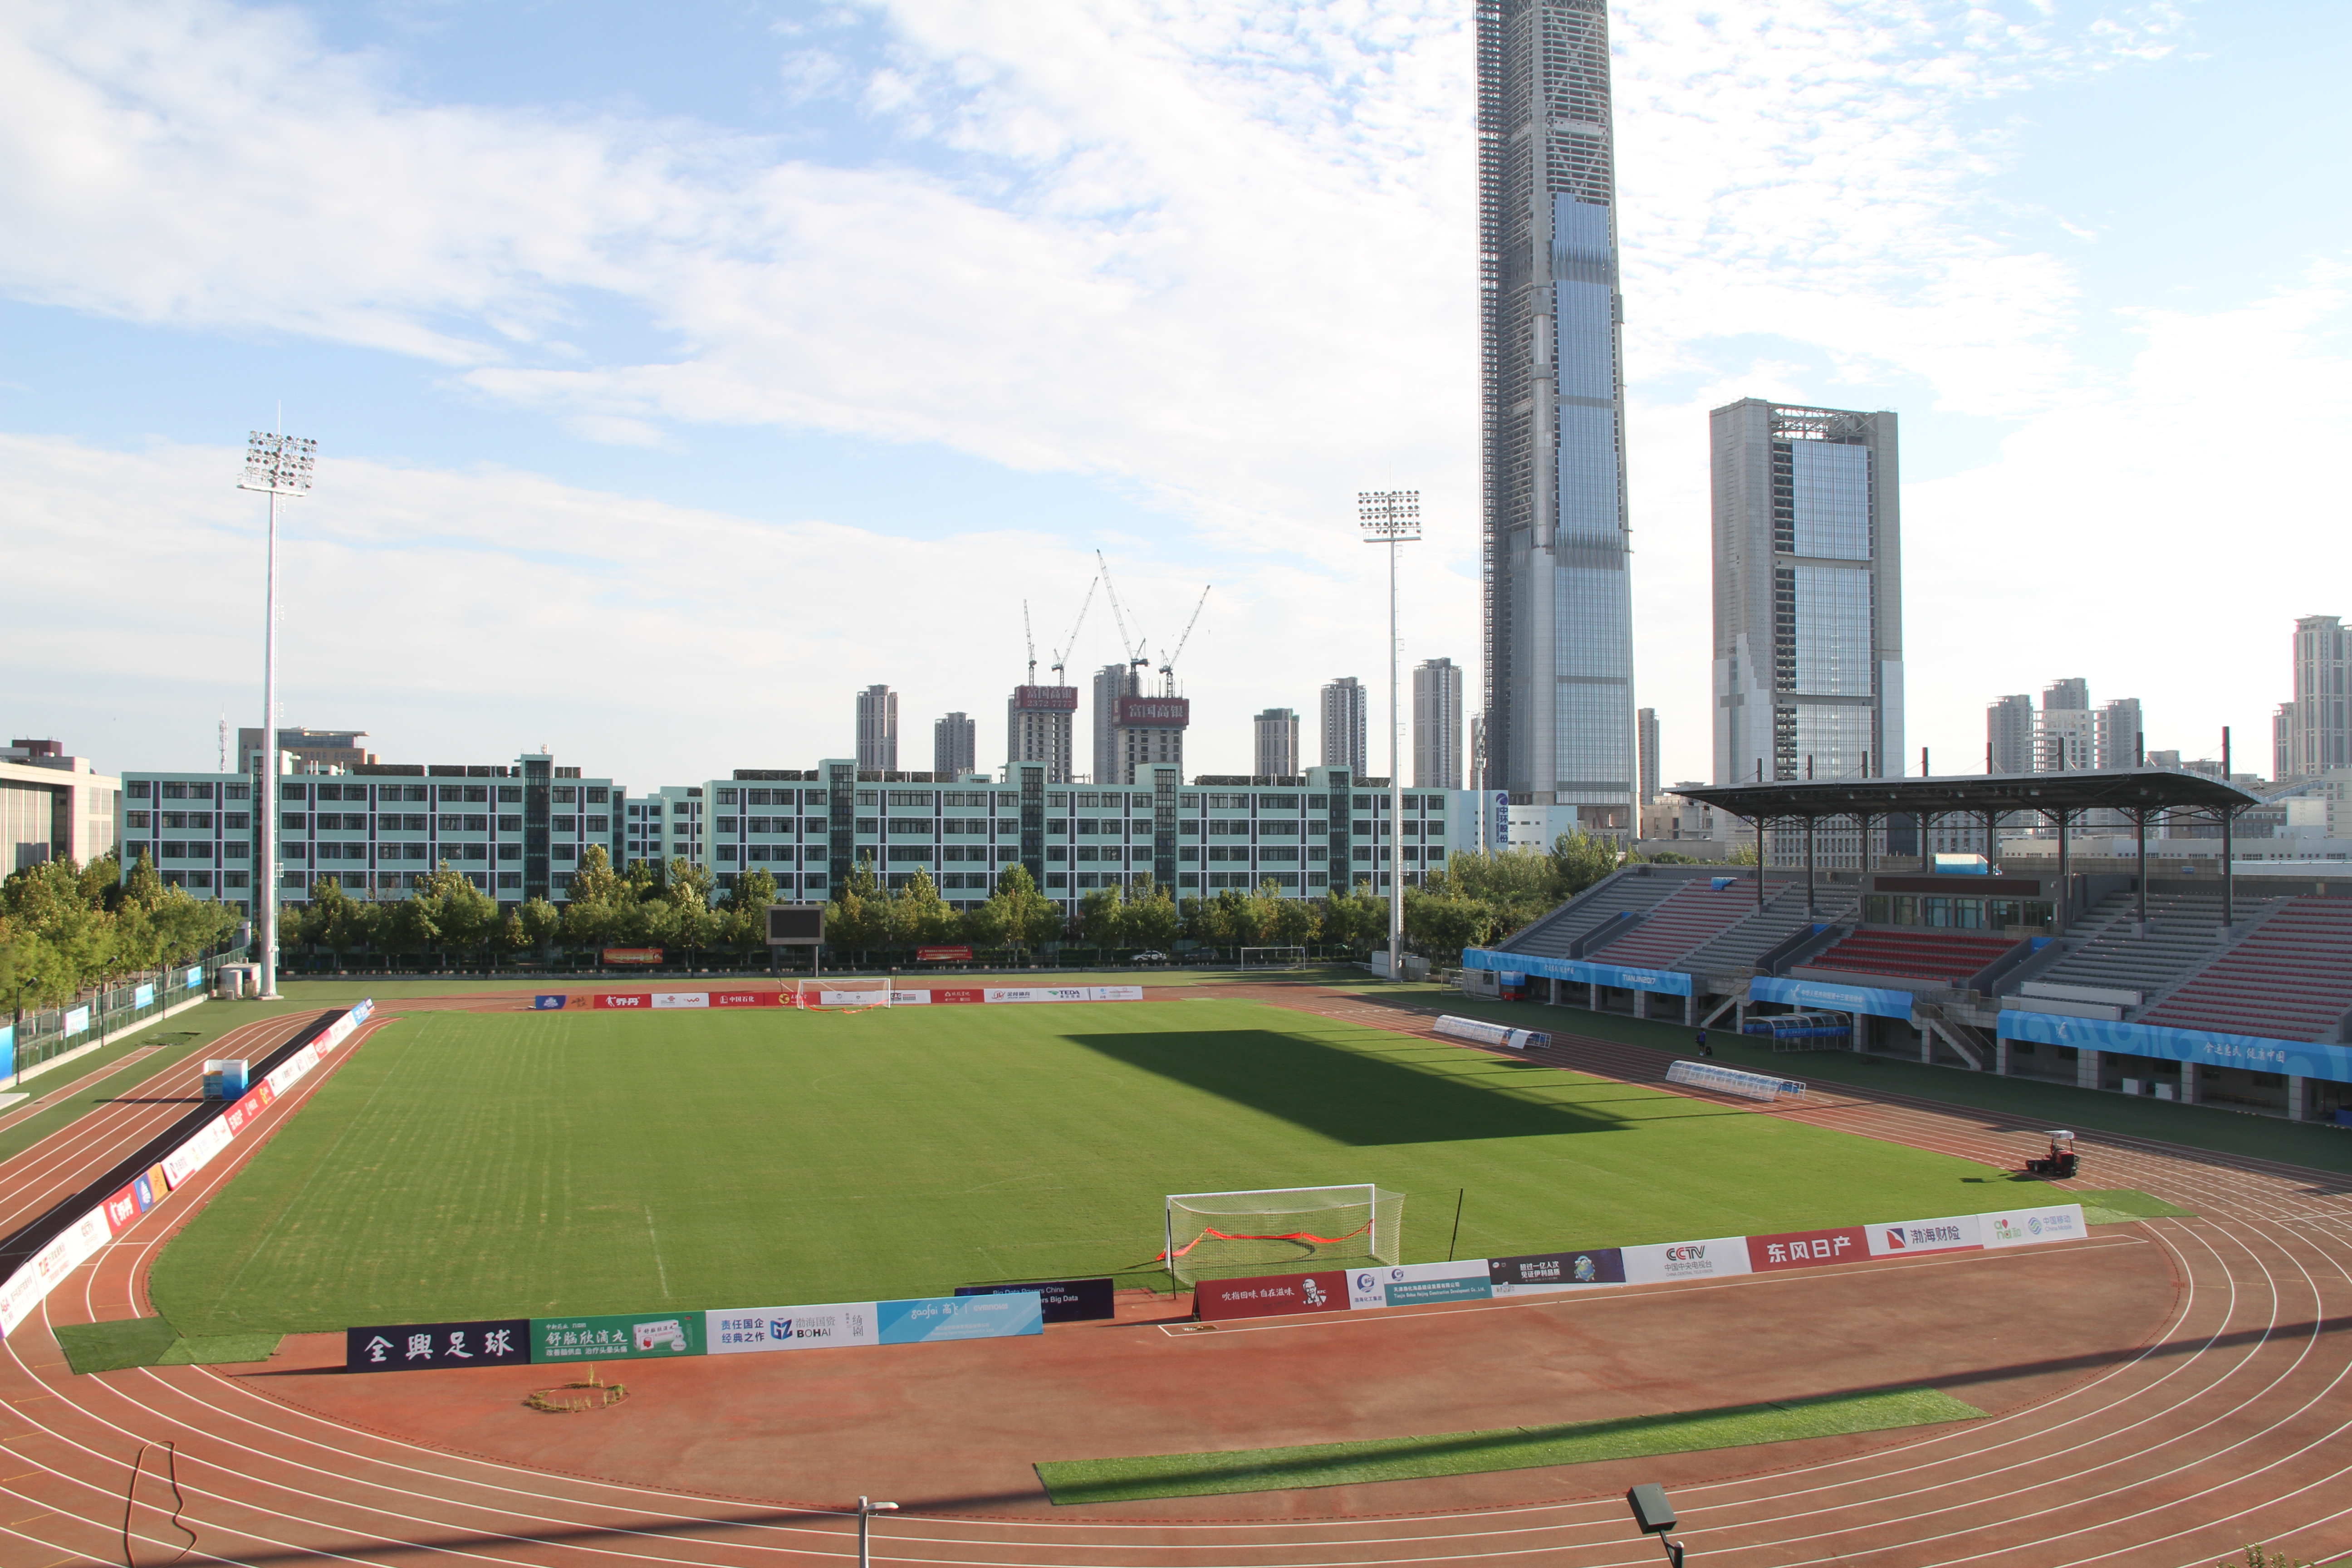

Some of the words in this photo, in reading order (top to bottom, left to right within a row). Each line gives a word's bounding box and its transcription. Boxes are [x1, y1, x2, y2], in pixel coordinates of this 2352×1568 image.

[1026, 686, 1072, 699] 富国高银
[1129, 704, 1184, 718] 富国高银
[1499, 806, 1508, 843] 中环股份
[1622, 974, 1656, 985] TIANJIN2017
[616, 997, 639, 1006] 乔丹
[2203, 1042, 2242, 1057] 全运惠民
[2247, 1047, 2285, 1063] 健康中国
[117, 1197, 133, 1221] 乔丹
[2043, 1215, 2071, 1225] 中国移动
[1910, 1226, 1961, 1244] 渤海财险
[1666, 1245, 1705, 1260] CCTV
[1767, 1235, 1851, 1263] 东风日产
[1520, 1261, 1559, 1271] 超过一亿人次
[1664, 1260, 1712, 1271] 中国中央电视台
[1521, 1268, 1561, 1279] 见证伊利品质
[1222, 1289, 1258, 1301] 吮指回味
[1260, 1287, 1294, 1297] 自在滋味
[911, 1303, 938, 1319] gaofei
[721, 1318, 764, 1330] 责任国企
[796, 1316, 836, 1328] 渤海国资
[545, 1329, 627, 1346] 舒脑欣滴丸
[722, 1332, 765, 1343] 经典之作
[797, 1328, 831, 1338] BOHAI
[364, 1329, 514, 1362] 全興足球
[585, 1346, 627, 1354] 治疗头晕头痛
